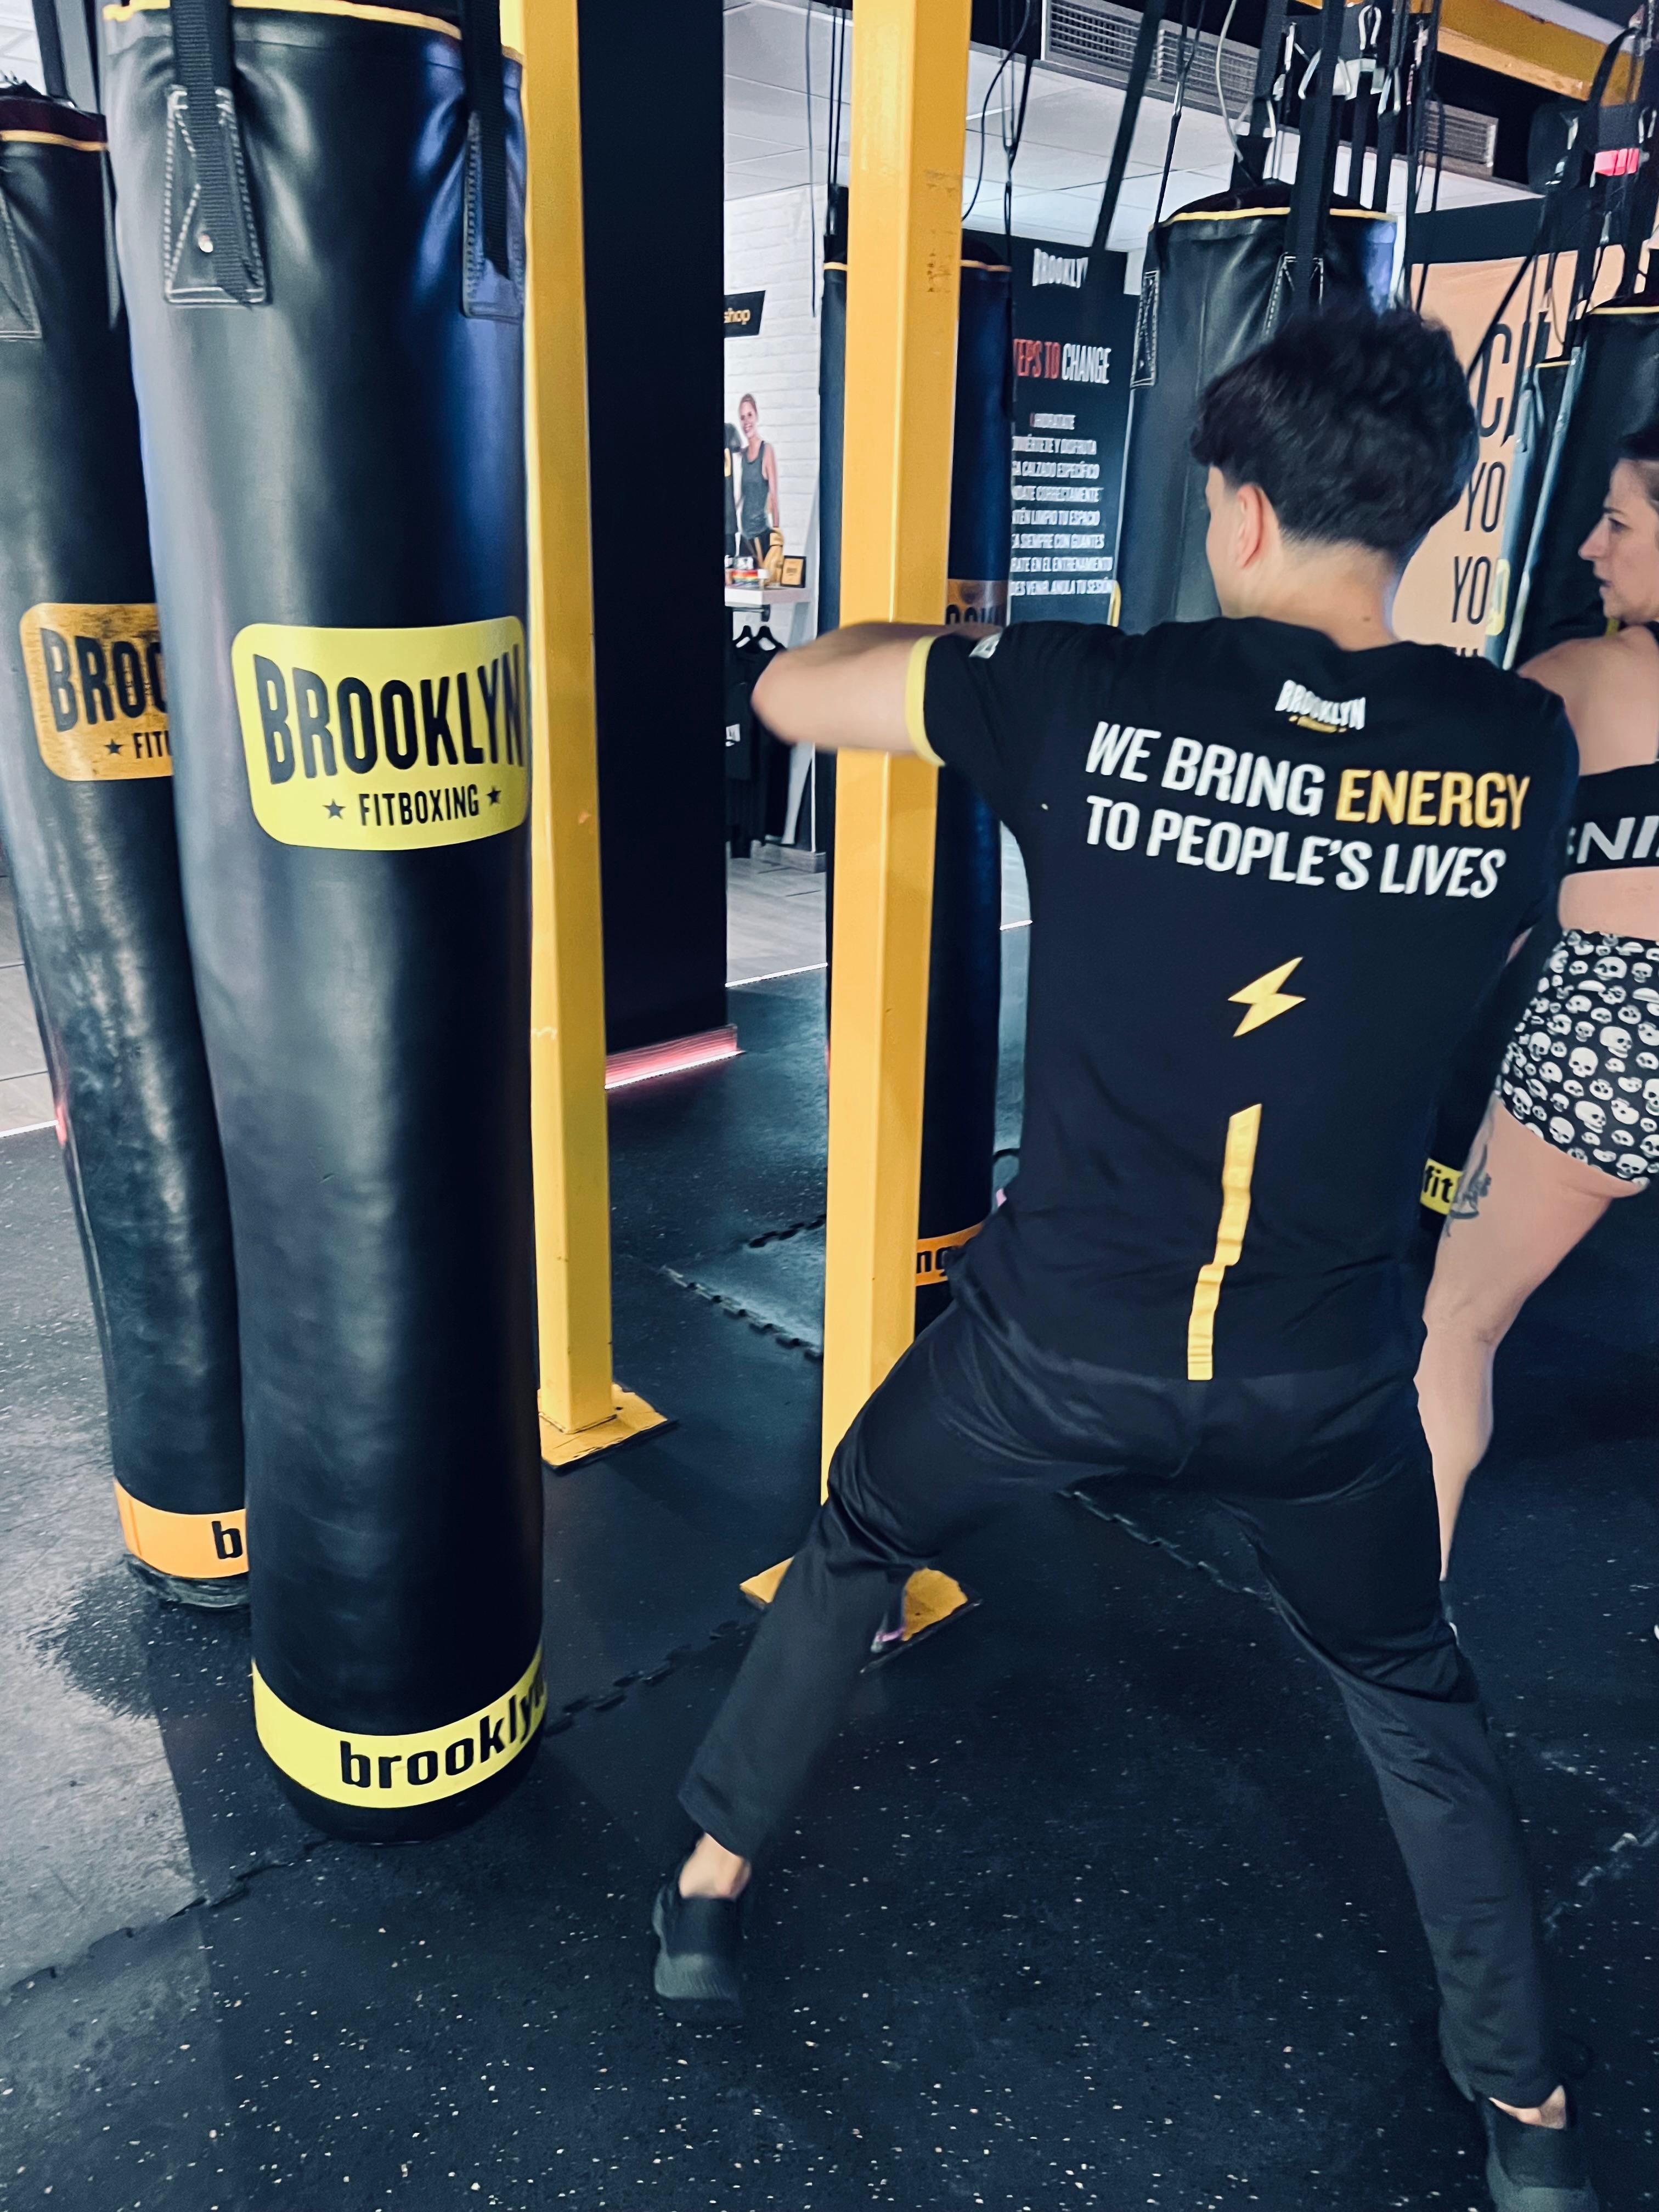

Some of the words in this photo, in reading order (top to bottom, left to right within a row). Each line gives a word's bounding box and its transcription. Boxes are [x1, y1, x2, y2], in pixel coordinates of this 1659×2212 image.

[1013, 338, 1042, 377] TEPS
[1043, 341, 1061, 379] TO
[1062, 343, 1111, 384] CHANGE
[253, 644, 524, 785] BROOKLYN
[1274, 679, 1365, 730] BROOKLYN
[359, 784, 479, 826] FITBOXING
[1085, 721, 1162, 782] WE
[1161, 737, 1325, 817] BRING
[1335, 769, 1531, 830] ENERGY
[1086, 795, 1141, 851] TO
[1146, 809, 1373, 891] PEOPLE'S
[1379, 843, 1506, 899] LIVES
